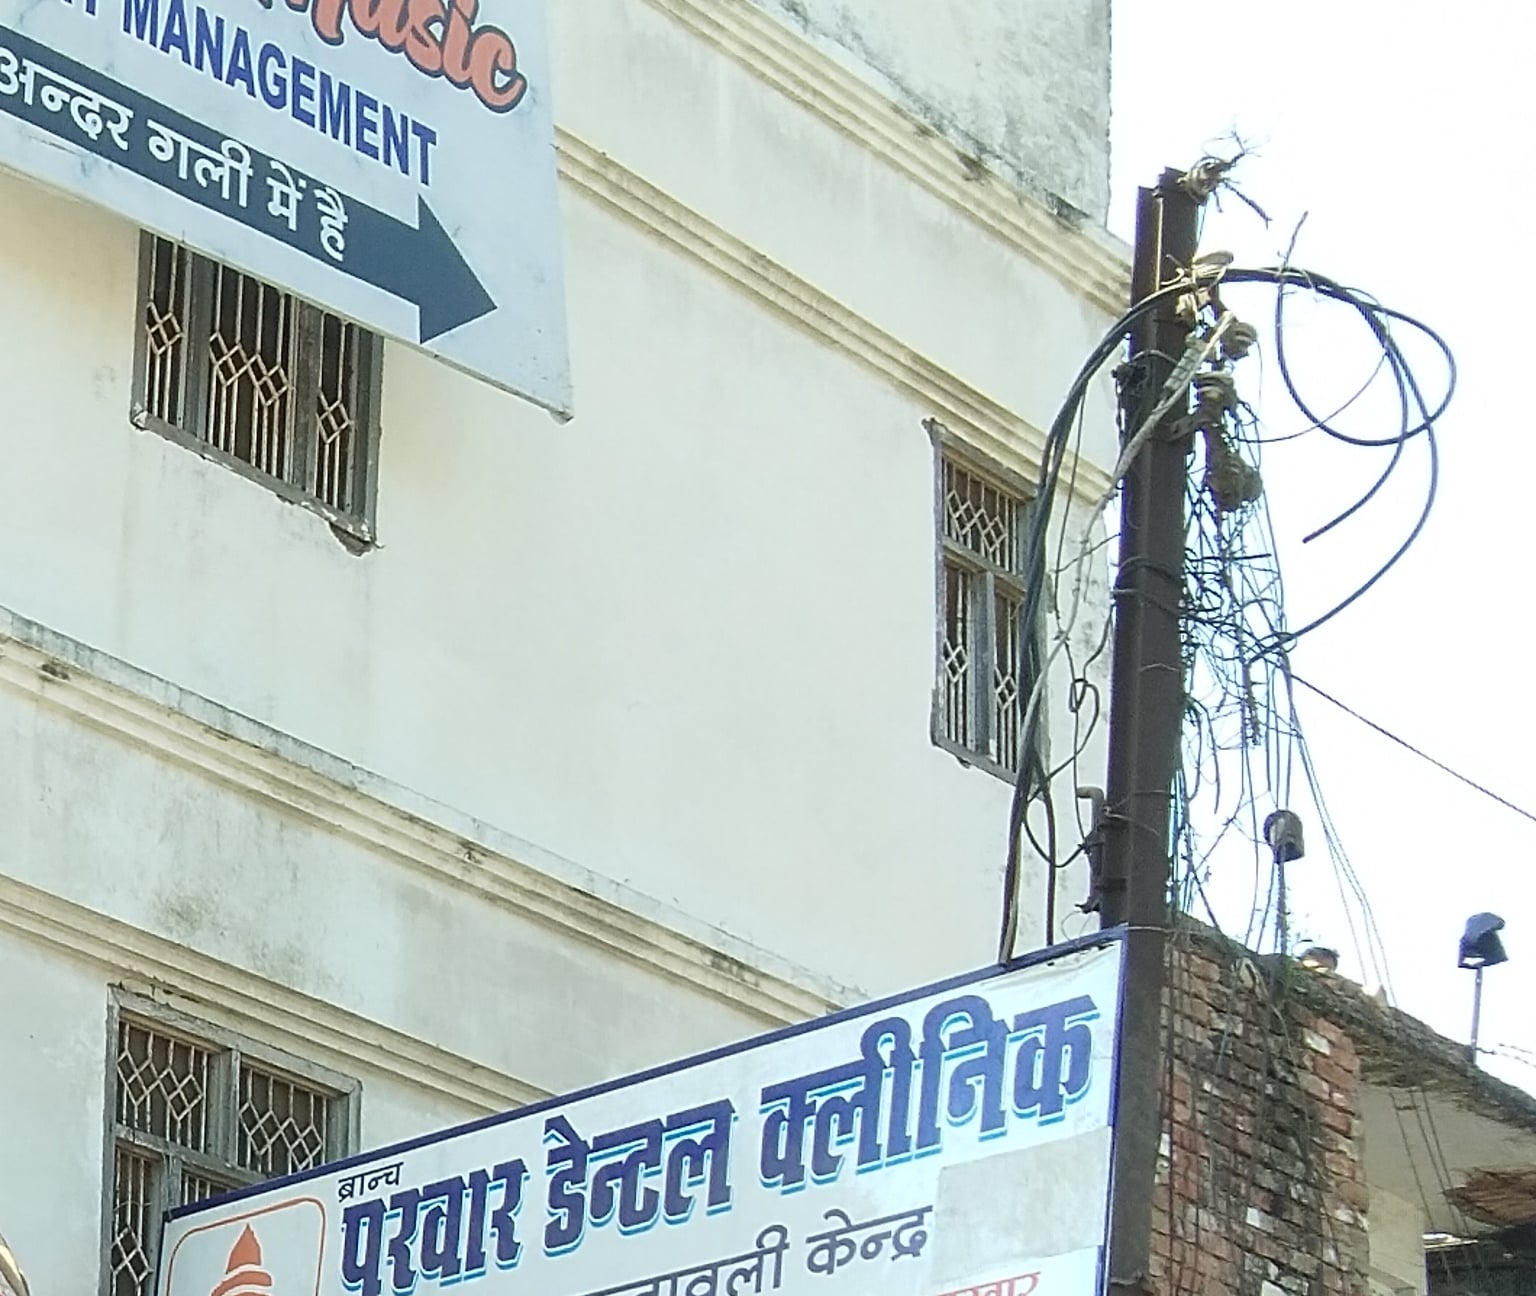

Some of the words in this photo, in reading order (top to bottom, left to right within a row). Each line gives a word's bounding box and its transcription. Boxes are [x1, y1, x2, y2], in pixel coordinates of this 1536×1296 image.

[123, 0, 438, 187] MANAGEMENT
[146, 117, 253, 208] गली
[265, 160, 303, 230] में
[313, 188, 349, 261] है
[337, 1161, 405, 1203] ब्रान्च
[541, 1098, 738, 1257] डेन्टल
[757, 994, 1100, 1194] क्लीनिक
[806, 1204, 934, 1280] केन्द्र
